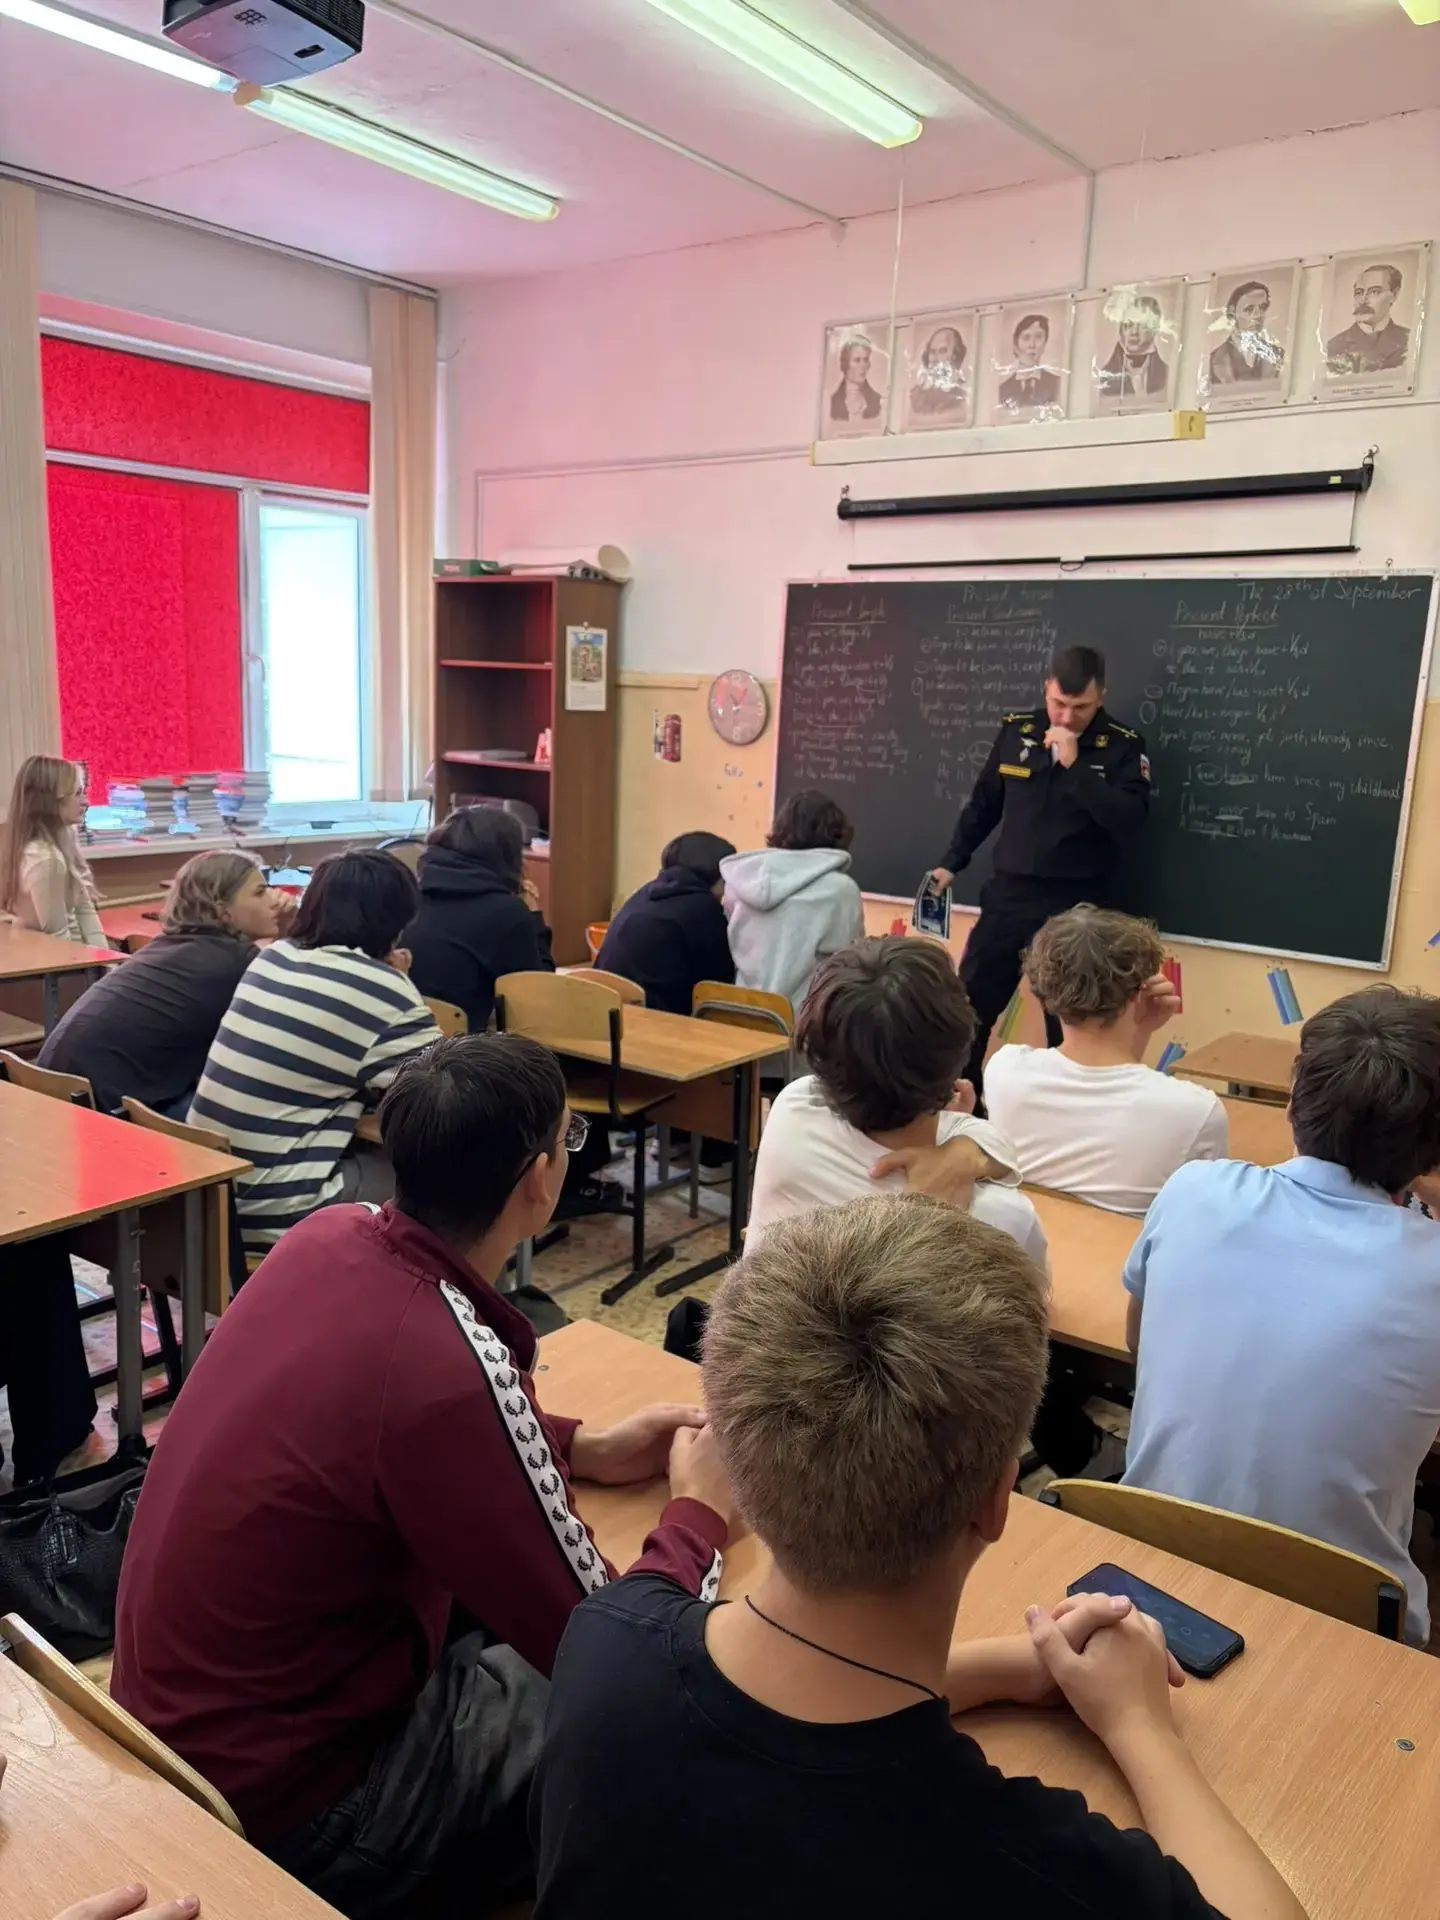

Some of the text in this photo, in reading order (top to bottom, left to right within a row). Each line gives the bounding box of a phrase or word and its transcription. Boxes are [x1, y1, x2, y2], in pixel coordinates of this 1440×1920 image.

[1236, 582, 1263, 601] The
[1333, 580, 1422, 609] September
[1174, 601, 1280, 628] Present Perfect
[1329, 780, 1346, 803] my
[1304, 801, 1338, 830] Spain
